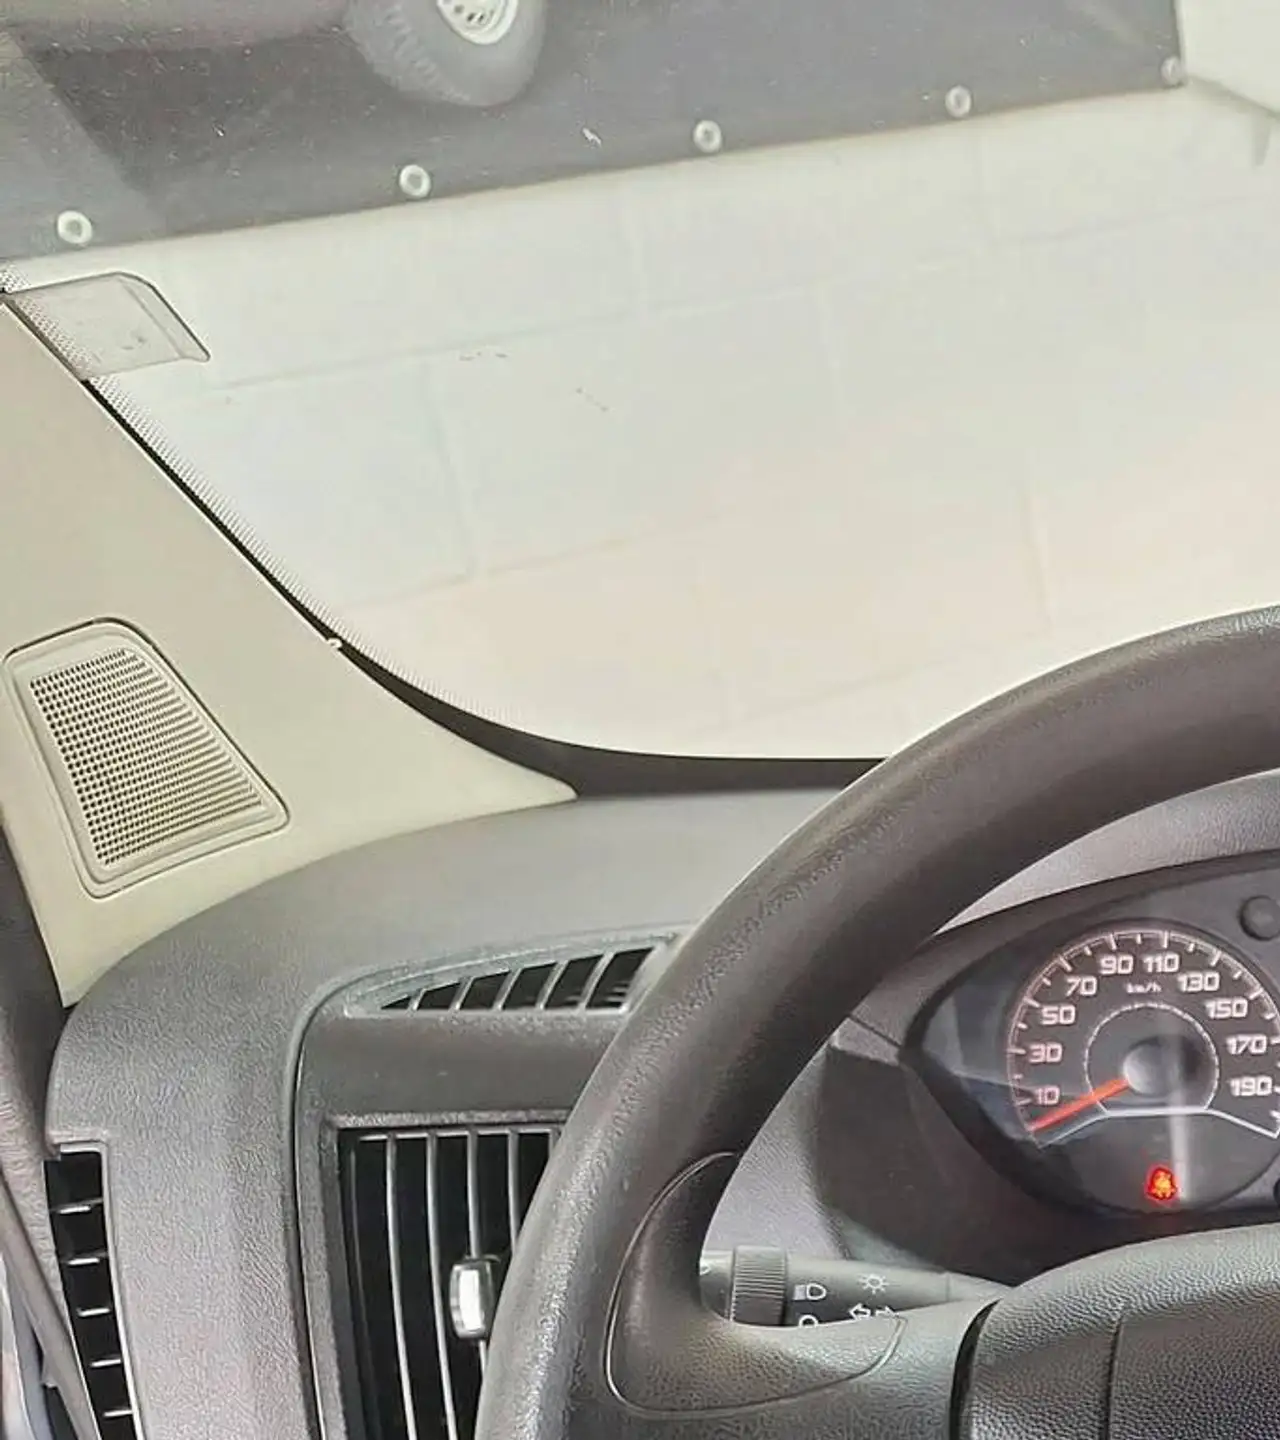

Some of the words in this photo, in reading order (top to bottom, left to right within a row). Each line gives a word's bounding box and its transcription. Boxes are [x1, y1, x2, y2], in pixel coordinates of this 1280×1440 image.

[1100, 954, 1133, 975] 90
[1142, 953, 1179, 973] 110
[1065, 976, 1097, 997] 70
[1177, 972, 1220, 992] 130
[1041, 1005, 1076, 1026] 50
[1205, 999, 1248, 1019] 150
[1029, 1042, 1063, 1063] 30
[1226, 1034, 1267, 1054] 170
[1034, 1086, 1060, 1105] 10
[1229, 1077, 1272, 1096] 190
